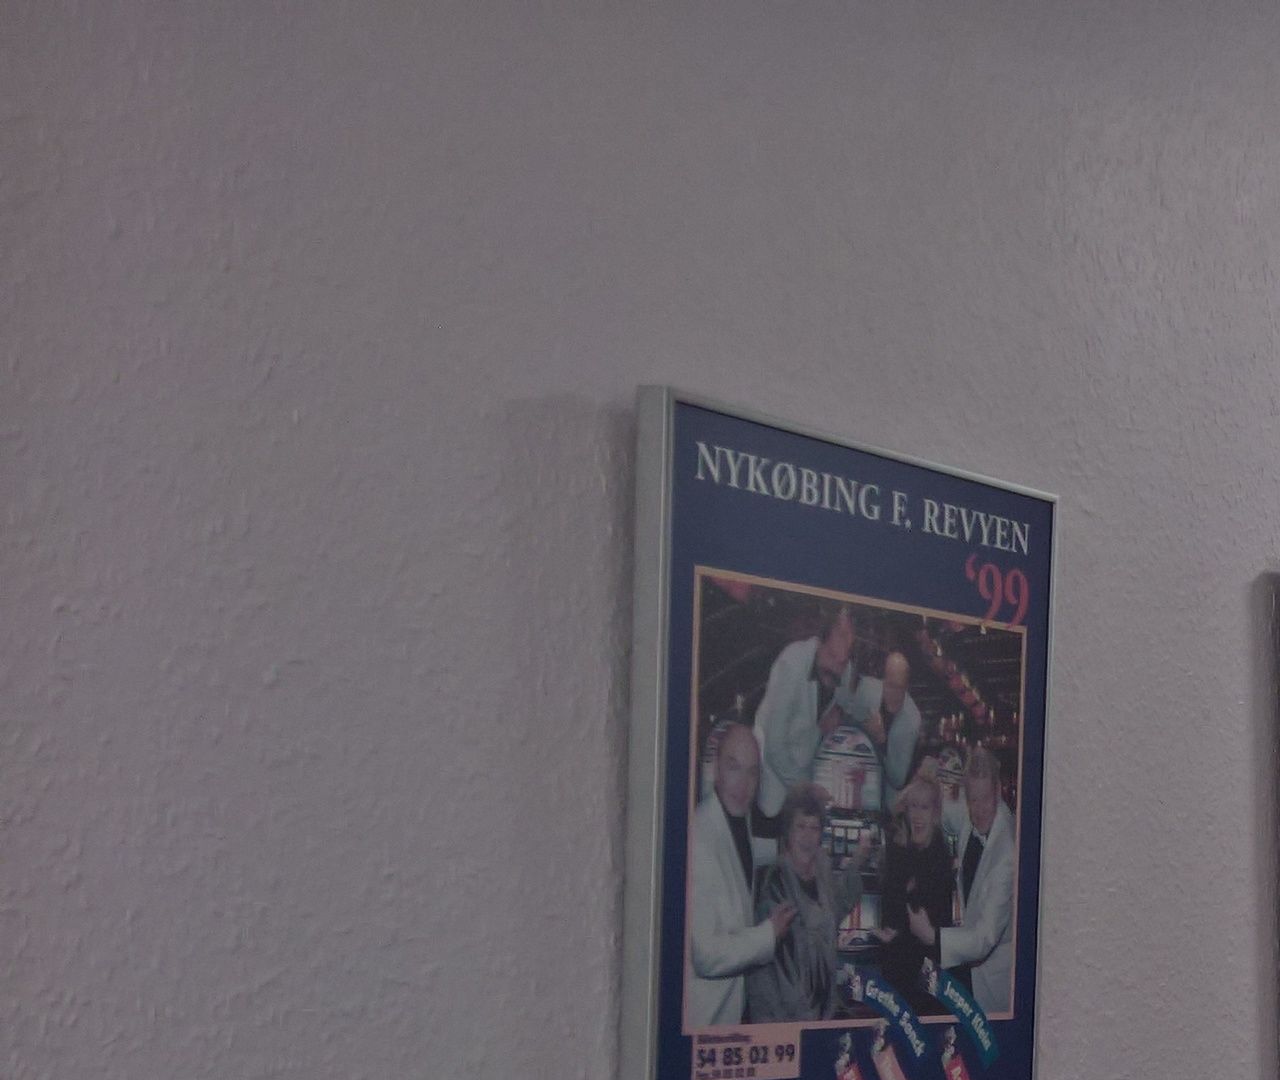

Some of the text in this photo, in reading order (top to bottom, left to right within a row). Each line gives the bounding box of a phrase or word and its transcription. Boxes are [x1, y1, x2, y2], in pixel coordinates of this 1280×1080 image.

[694, 441, 1030, 556] NYKØBING F. REVYEN
[943, 980, 992, 1051] Jesper Klein
[697, 1047, 717, 1068] 54
[749, 1045, 769, 1064] 02
[774, 1043, 796, 1063] 99
